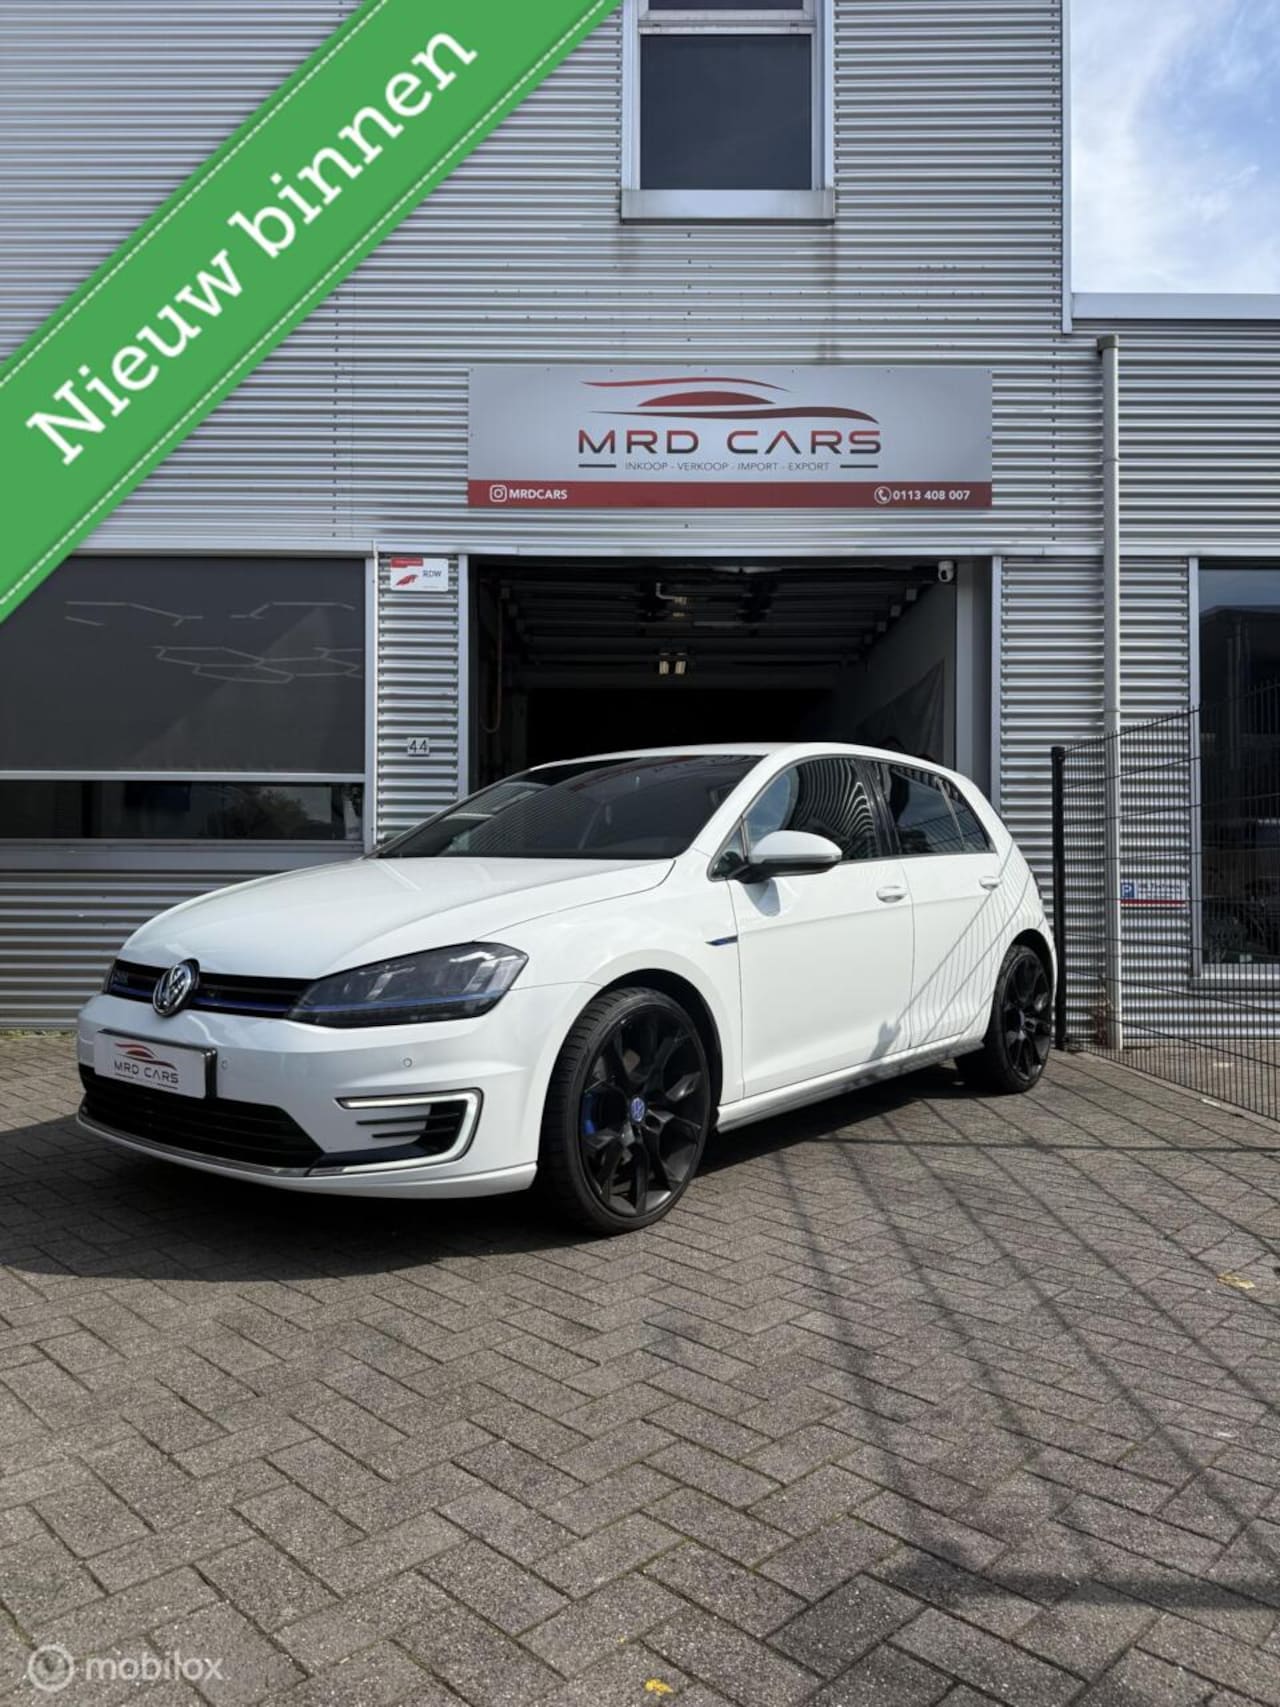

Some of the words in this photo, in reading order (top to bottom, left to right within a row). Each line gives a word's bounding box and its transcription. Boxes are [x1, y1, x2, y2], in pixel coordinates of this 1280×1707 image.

[578, 429, 699, 454] MRD
[726, 429, 882, 455] CARS
[625, 461, 668, 472] INKOOP
[677, 461, 729, 472] VERKOOP
[737, 461, 778, 472] IMPORT
[788, 461, 830, 472] EXPORT
[509, 488, 568, 501] MRDCARS
[892, 489, 921, 501] 0113
[924, 489, 946, 501] 408
[949, 489, 971, 501] 007
[422, 569, 442, 577] RDW
[410, 739, 428, 753] 44
[114, 1060, 139, 1075] MRD
[143, 1067, 179, 1084] CARS
